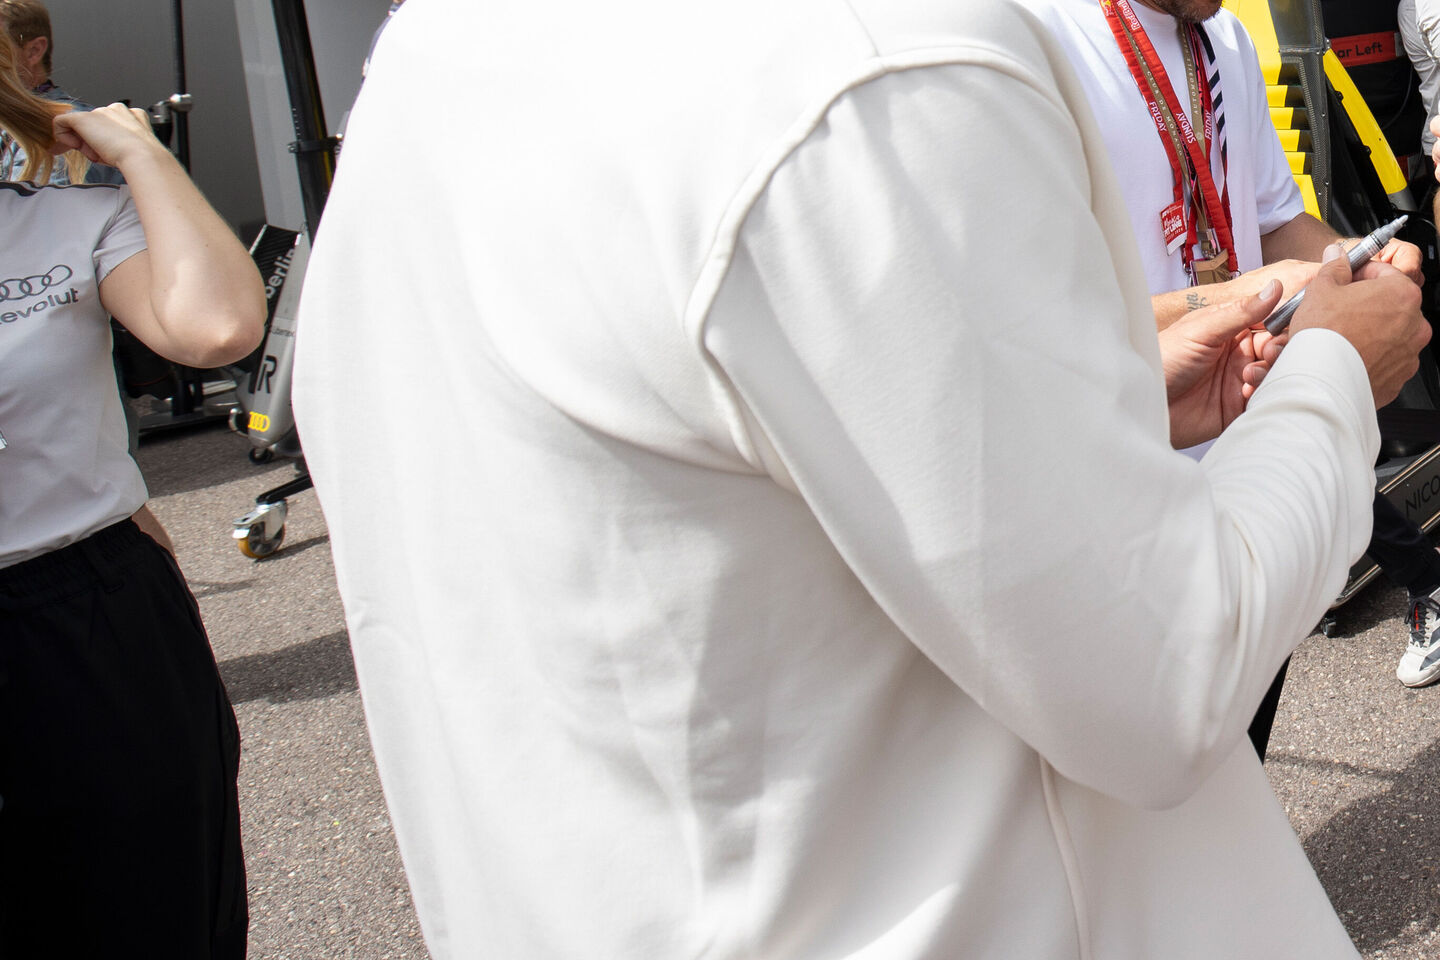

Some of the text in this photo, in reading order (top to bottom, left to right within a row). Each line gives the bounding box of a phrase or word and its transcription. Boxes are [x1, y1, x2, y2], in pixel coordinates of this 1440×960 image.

[1356, 42, 1383, 57] Left
[1149, 101, 1168, 132] FRIDAY
[1159, 100, 1166, 111] DE
[1166, 115, 1183, 156] MONACO
[1176, 113, 1197, 144] SUNDAY
[1204, 110, 1212, 140] FRIDAY
[0, 288, 79, 324] evolut
[1404, 474, 1440, 517] NICO
